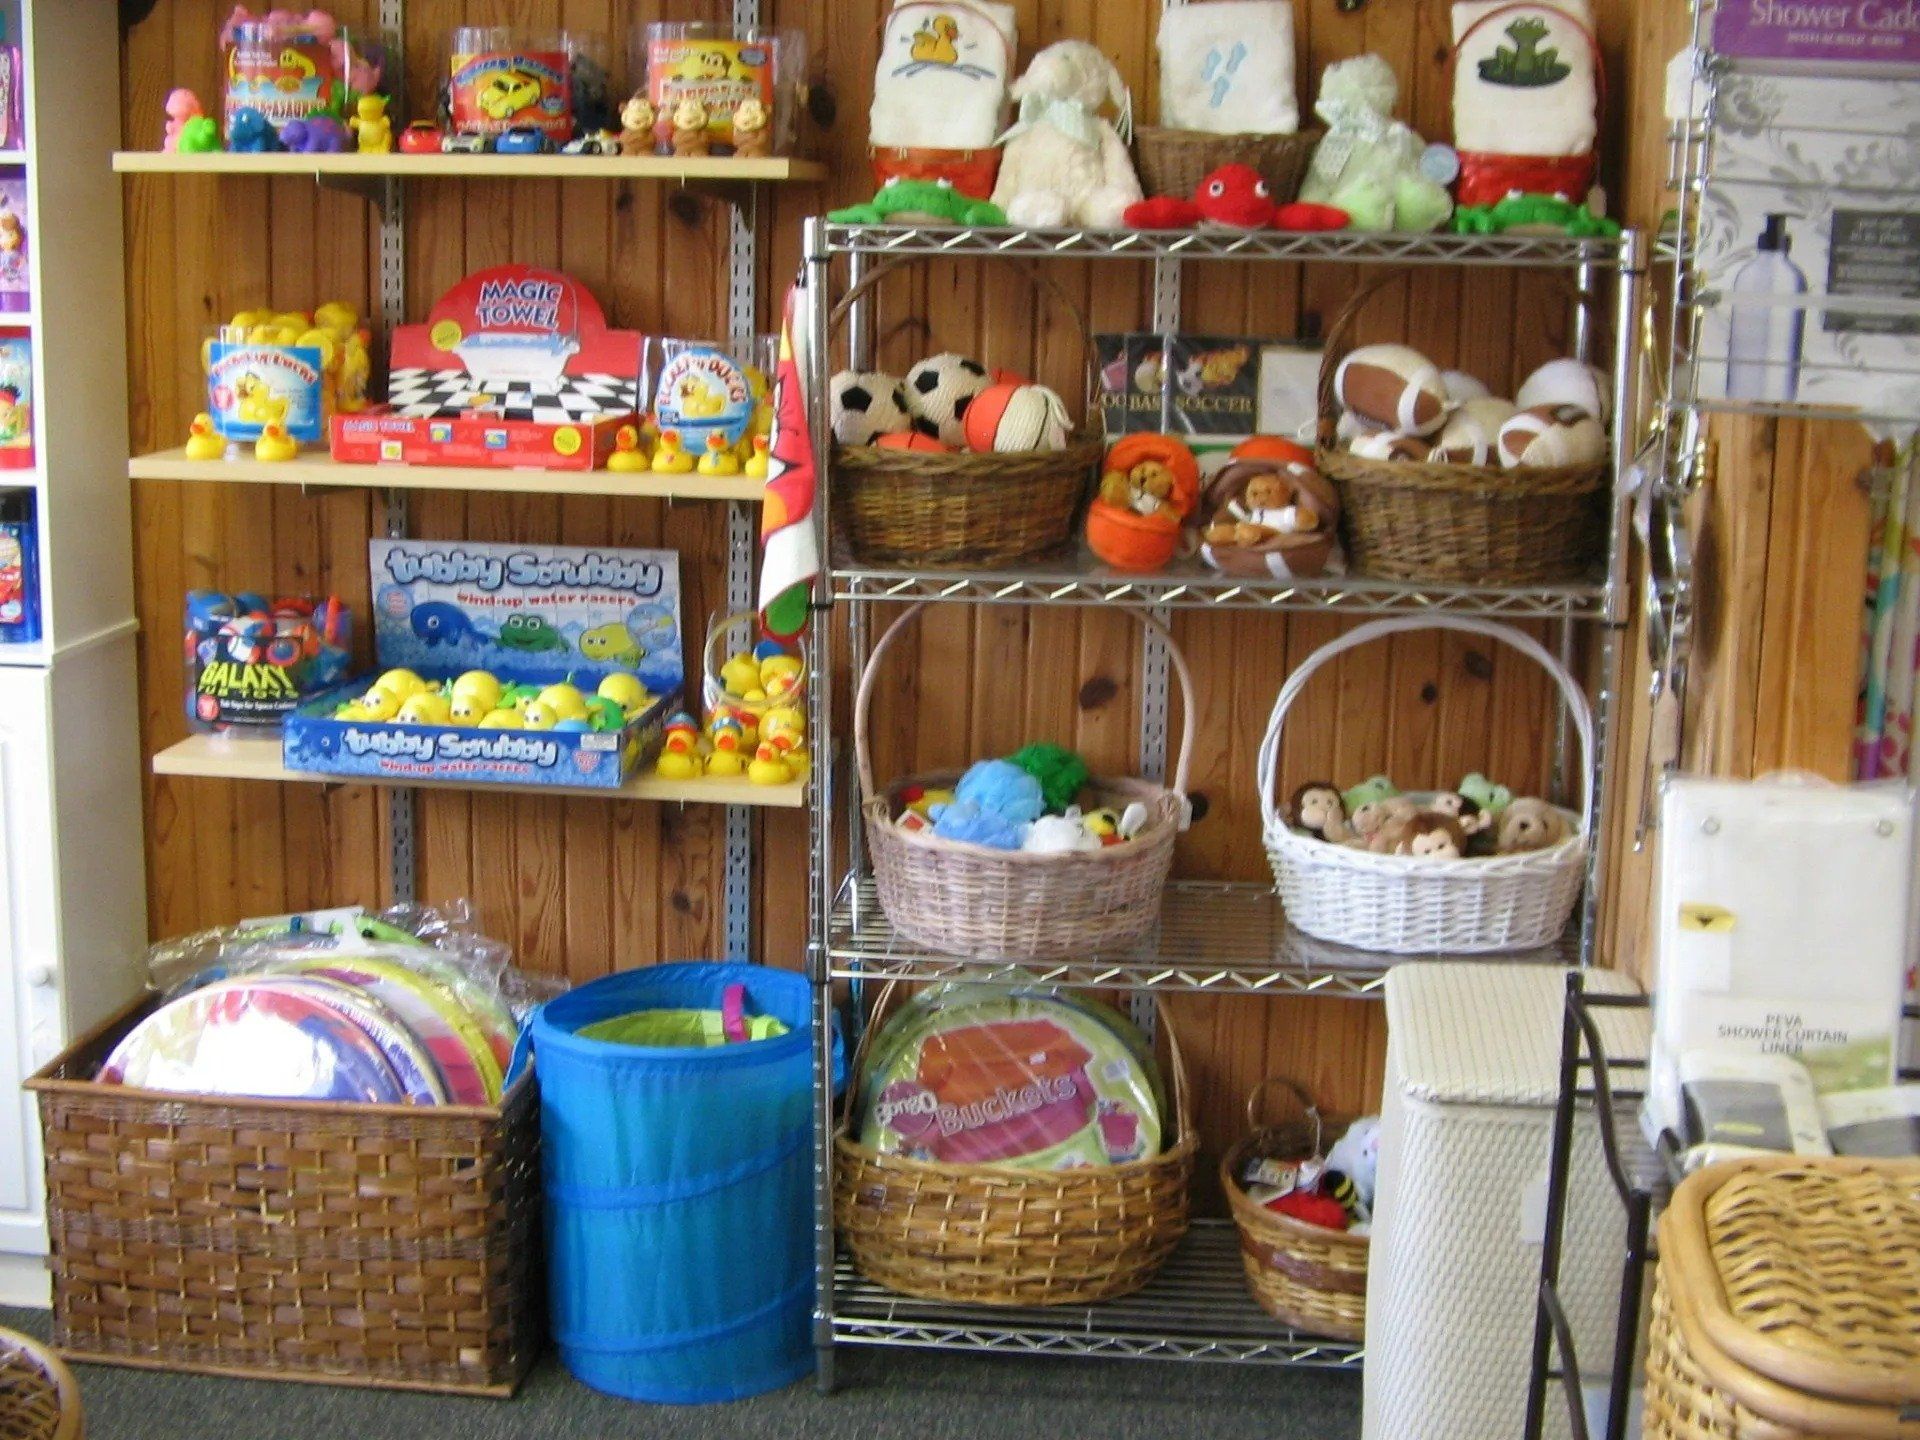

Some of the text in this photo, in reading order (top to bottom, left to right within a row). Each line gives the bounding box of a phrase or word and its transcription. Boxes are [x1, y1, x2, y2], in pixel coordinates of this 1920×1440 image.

[481, 278, 564, 303] MAGIC
[477, 302, 560, 330] TOWEL
[505, 552, 663, 596] Scrubby
[456, 591, 636, 608] wind-up water racers
[199, 662, 295, 690] GALAXY
[437, 733, 558, 767] Scrubby
[1717, 1023, 1848, 1044] SHOWER CURTAIN
[1761, 1040, 1803, 1056] LINER
[939, 1076, 1077, 1136] Buckets
